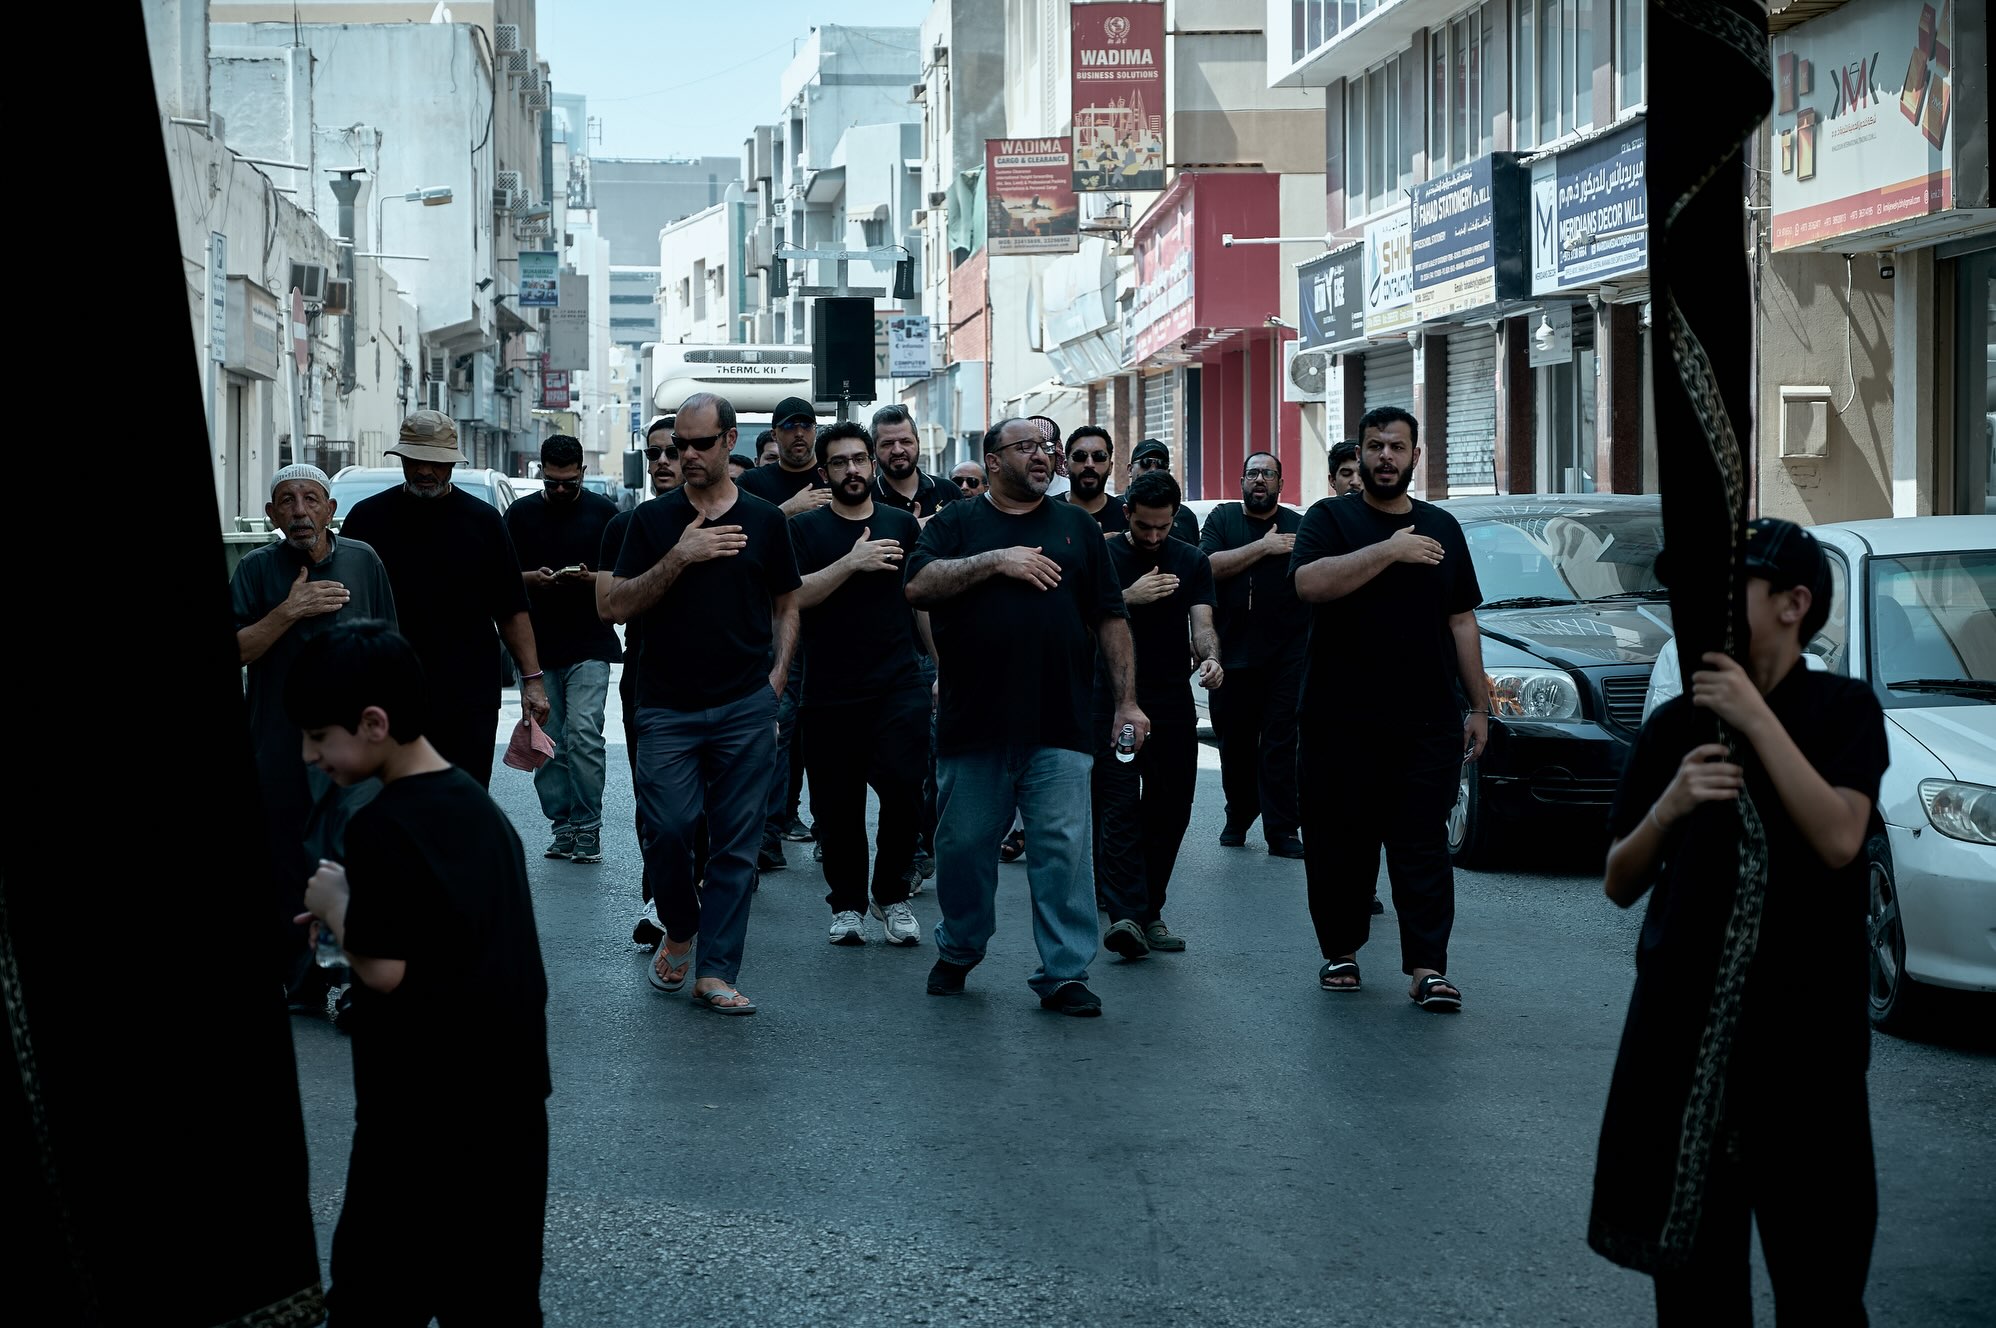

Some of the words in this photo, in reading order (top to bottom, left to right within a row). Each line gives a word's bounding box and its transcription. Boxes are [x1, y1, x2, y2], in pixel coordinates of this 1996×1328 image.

[1080, 48, 1154, 65] WADIMA
[1076, 71, 1115, 80] BUSINESS
[1116, 70, 1159, 78] SOLUTIONS
[1001, 139, 1062, 154] WADIMA
[1027, 155, 1066, 163] CLEARANCE
[1579, 167, 1606, 204] للديكور
[1419, 199, 1438, 228] FAHAD
[1438, 185, 1473, 220] STATIONERY
[1559, 210, 1597, 243] MERIDIANS
[1597, 202, 1623, 232] DECOR
